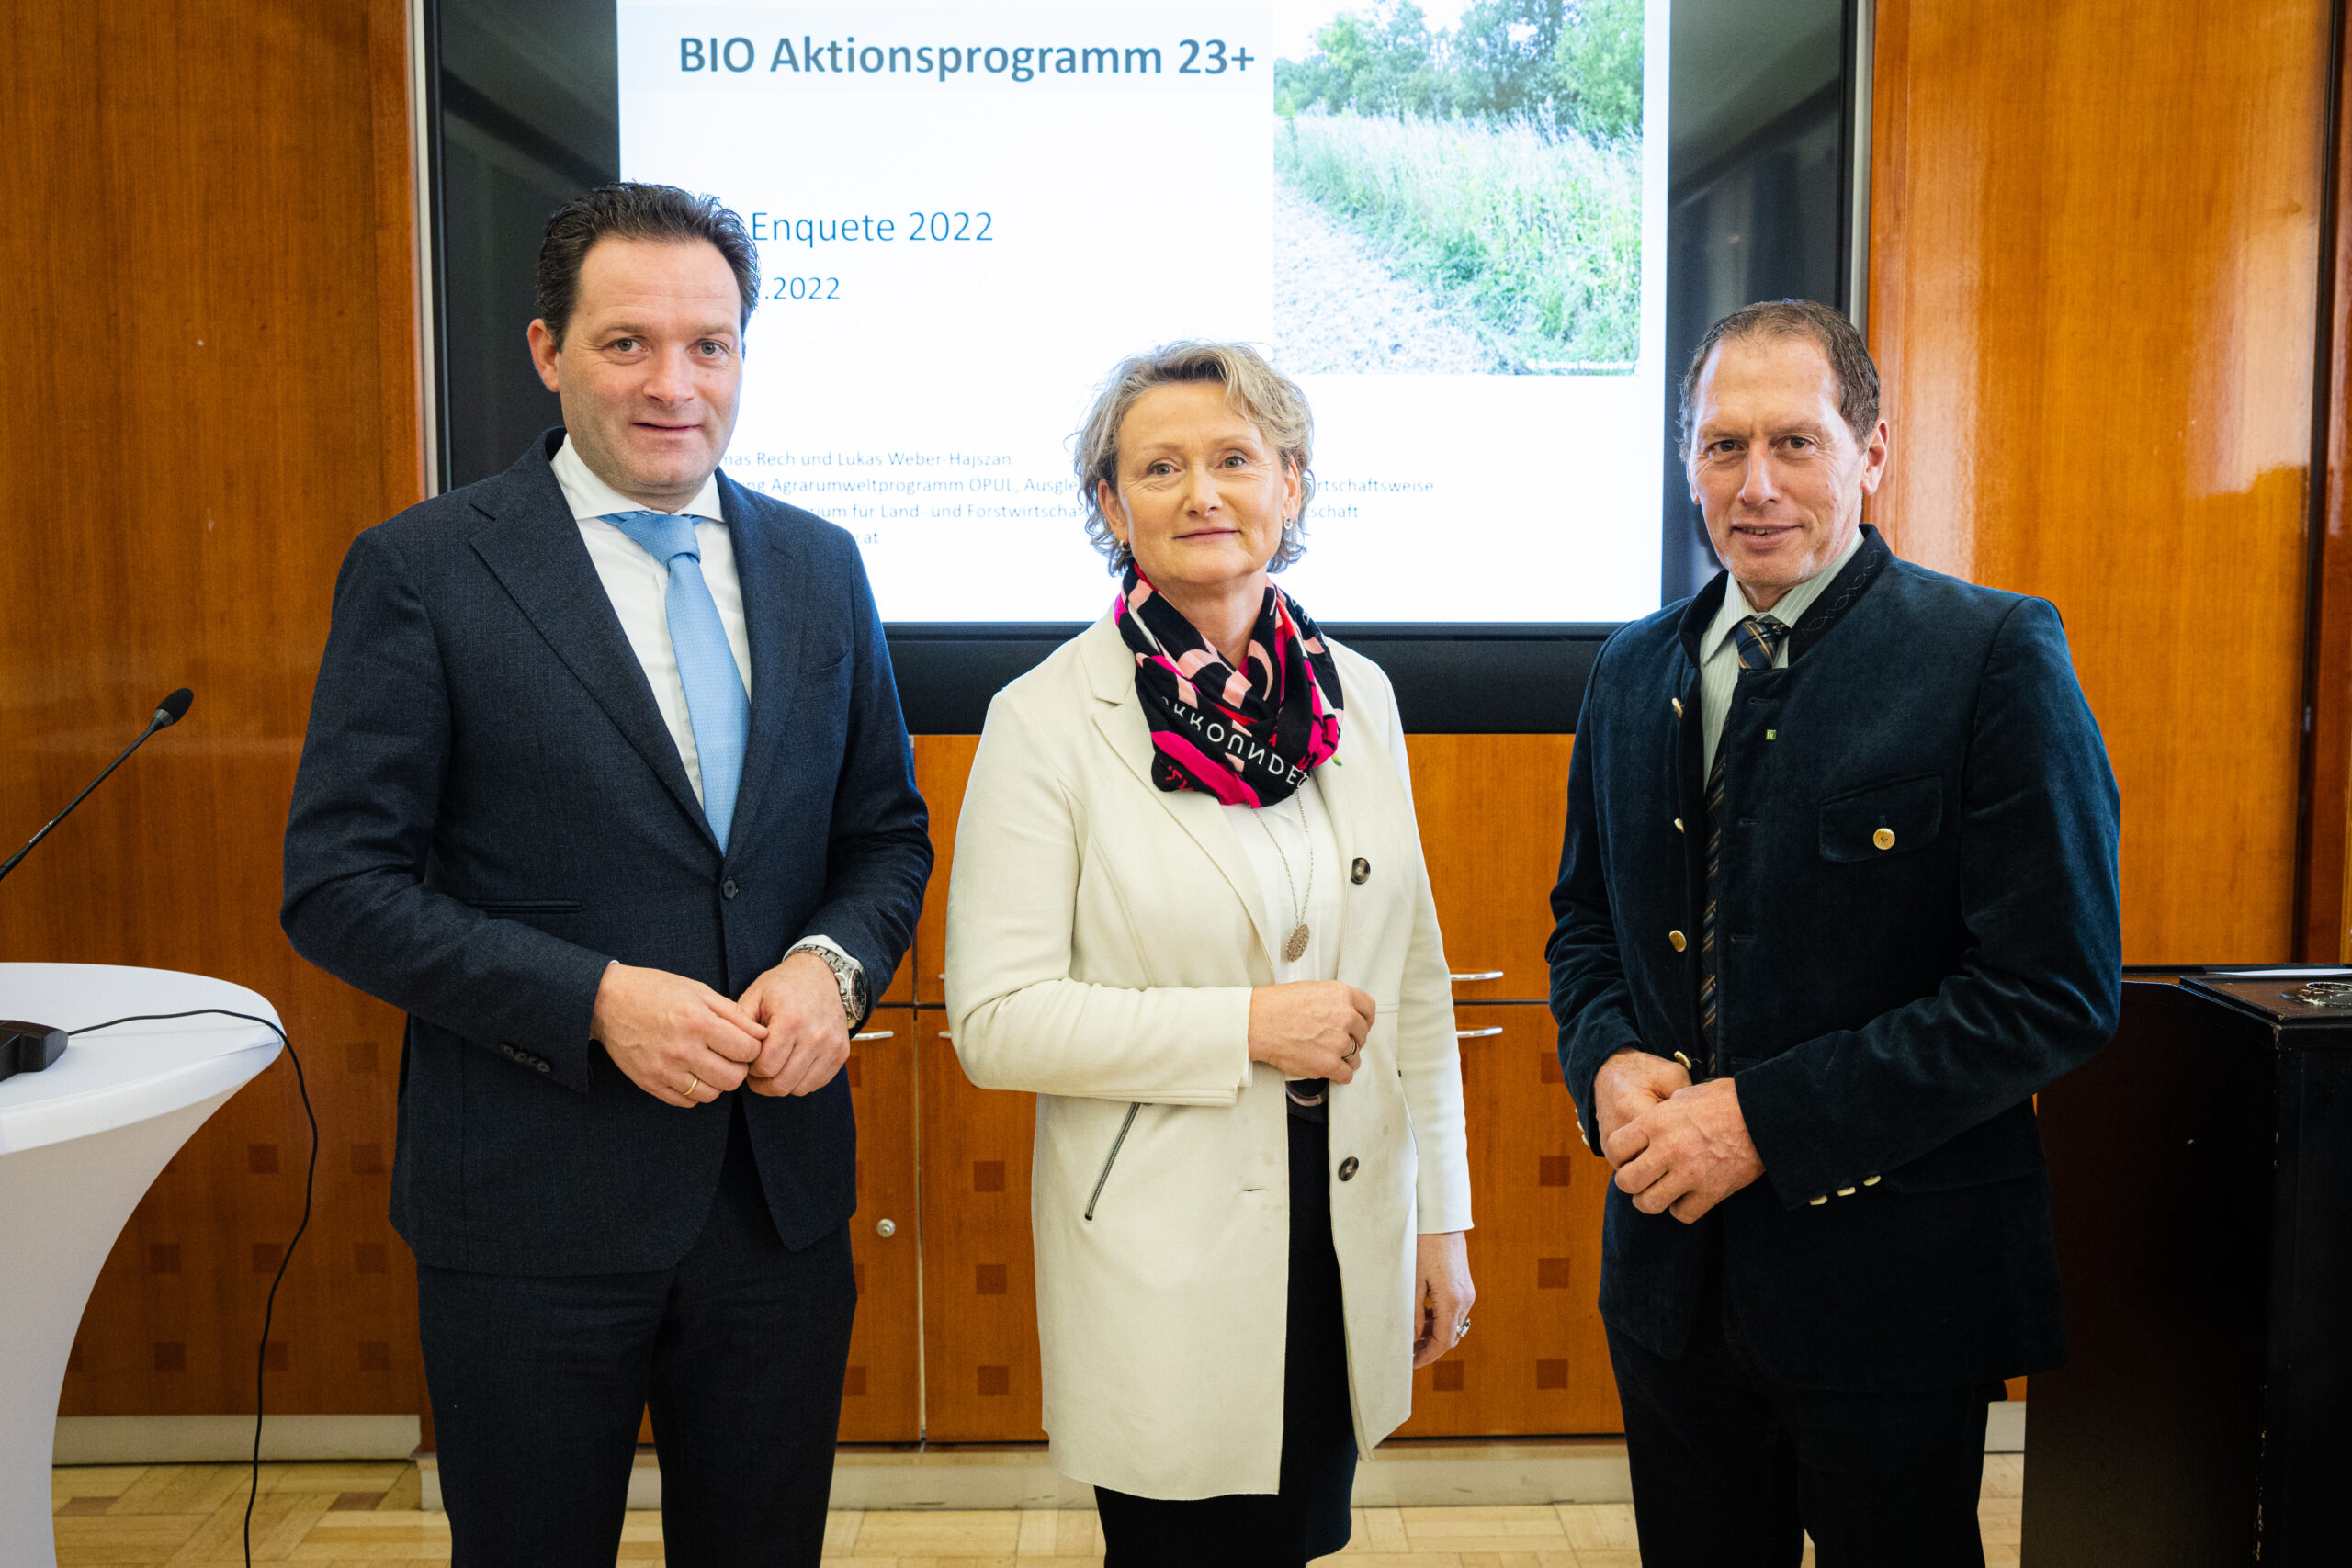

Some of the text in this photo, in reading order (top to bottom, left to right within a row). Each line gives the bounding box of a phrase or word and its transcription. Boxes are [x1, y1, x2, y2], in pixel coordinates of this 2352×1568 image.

[679, 35, 1255, 83] BIO Aktionsprogramm 23+
[752, 212, 993, 248] Enquete 2022
[763, 276, 841, 299] .2022
[756, 451, 795, 466] Rech
[801, 451, 831, 466] und
[837, 451, 883, 466] Lukas
[771, 478, 964, 494] Agrarumweltprogramm
[1317, 478, 1434, 492] rtschaftsweise
[931, 504, 962, 518] und
